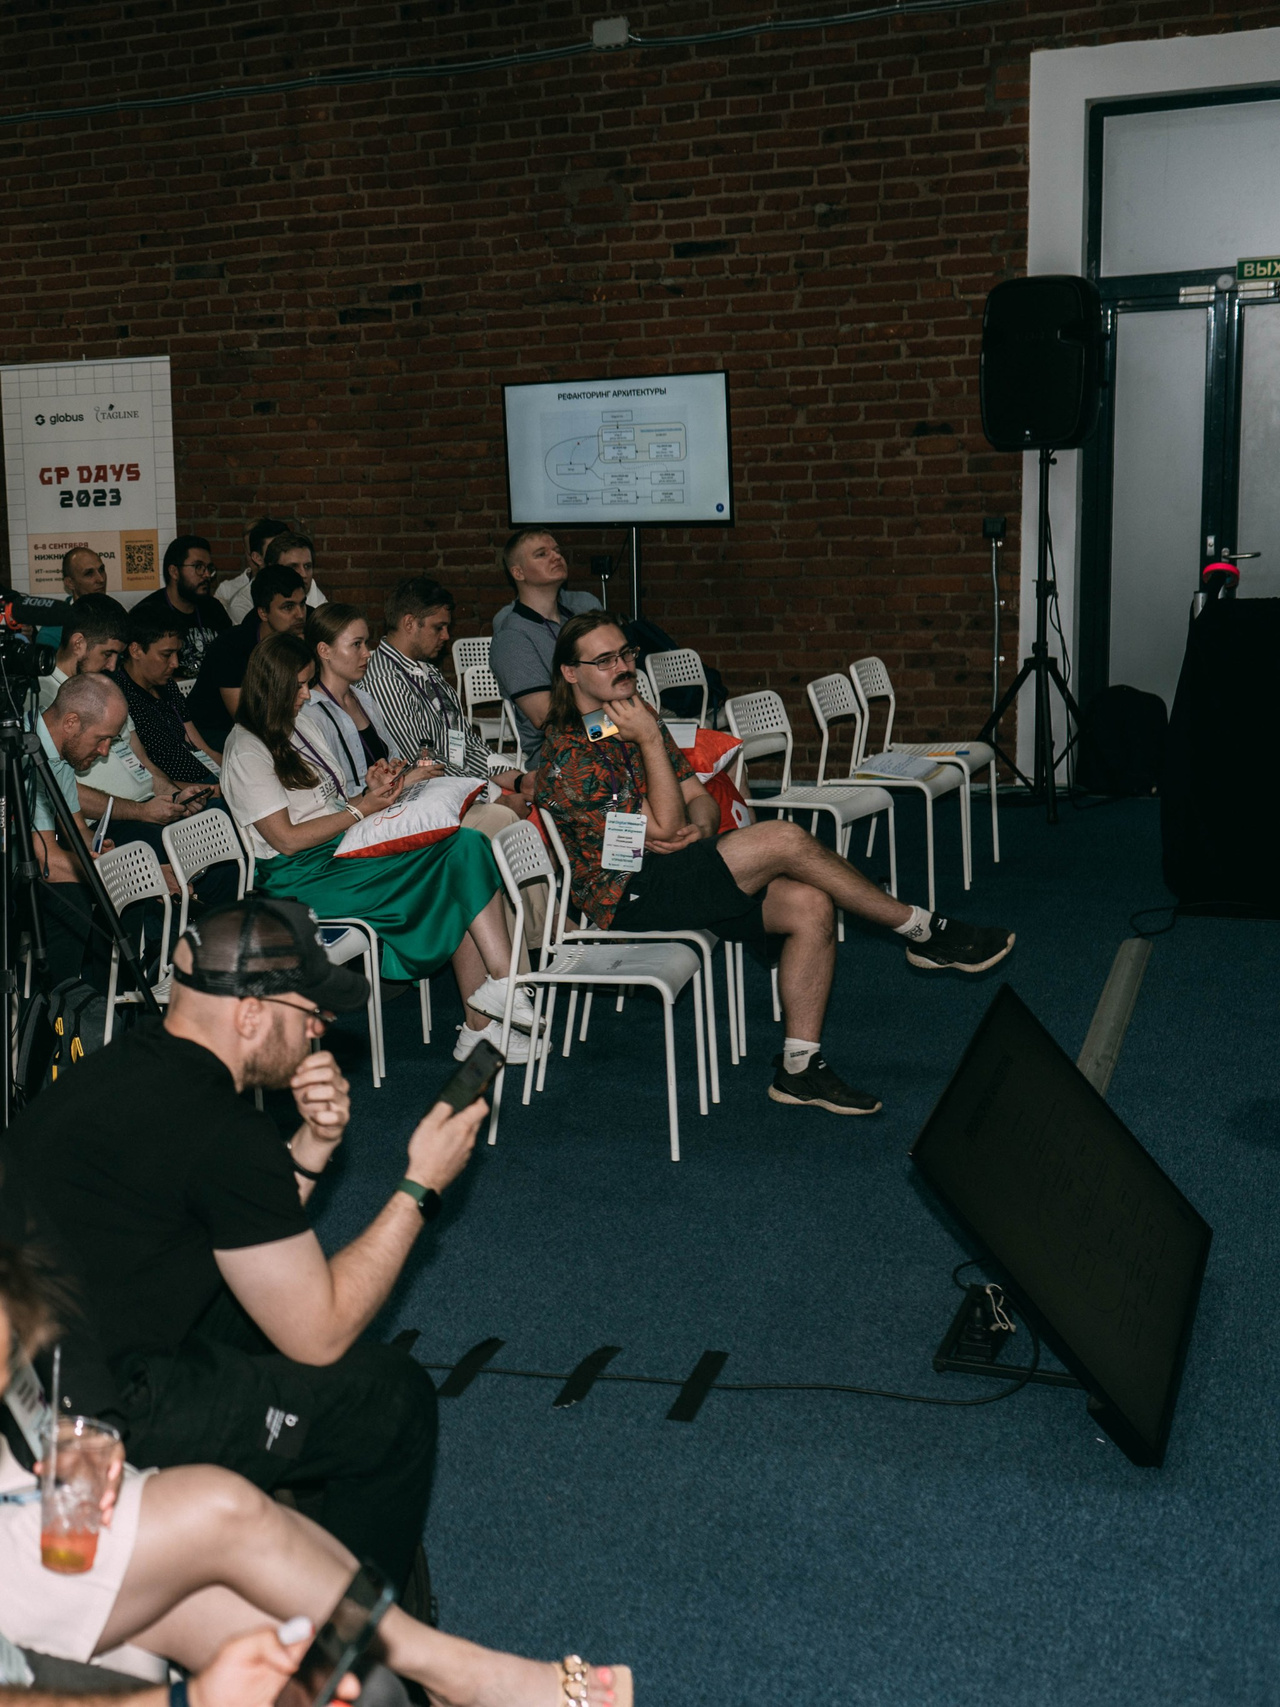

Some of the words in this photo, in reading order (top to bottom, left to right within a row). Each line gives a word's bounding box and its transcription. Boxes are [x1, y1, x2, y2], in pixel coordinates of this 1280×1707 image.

[558, 390, 611, 400] РЕФАКТОРИНГ
[612, 388, 667, 398] АРХИТЕКТУРЫ
[49, 413, 84, 425] globus
[100, 410, 139, 421] TAGLINE
[39, 467, 70, 485] GP
[76, 463, 141, 483] DAYS
[59, 488, 122, 508] 2023
[48, 542, 89, 550] СЕНТЯБРЯ
[34, 553, 66, 561] НИЖНИ
